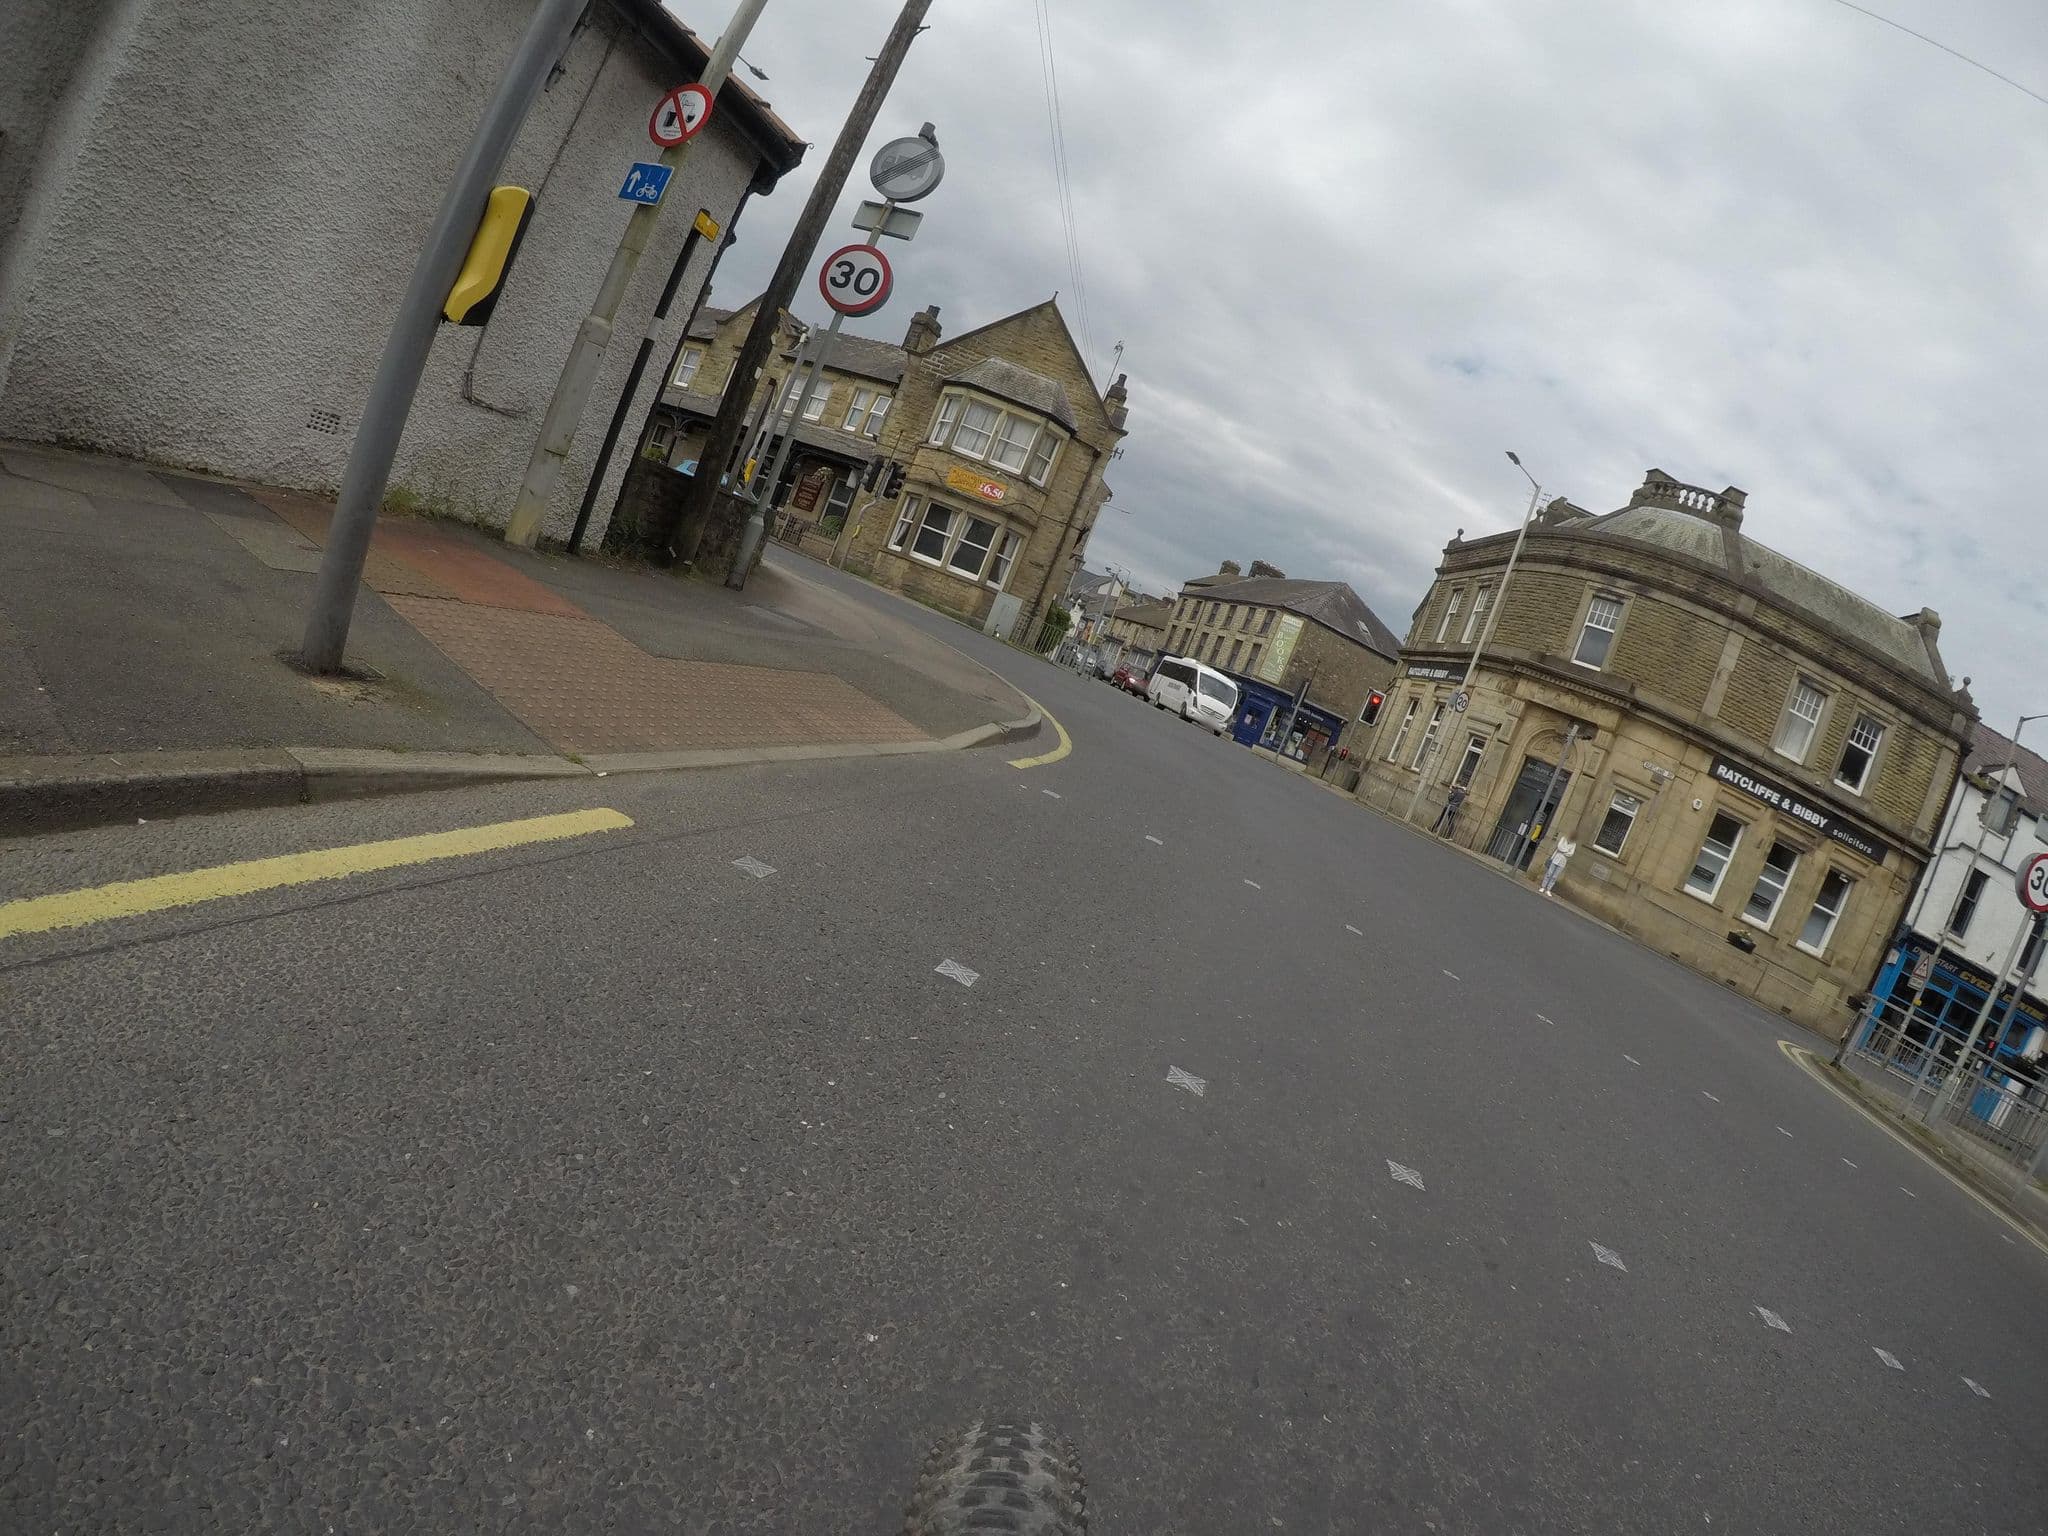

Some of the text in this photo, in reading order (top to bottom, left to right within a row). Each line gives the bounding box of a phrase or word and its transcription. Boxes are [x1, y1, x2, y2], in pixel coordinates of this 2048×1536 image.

[830, 260, 880, 296] 30
[1457, 697, 1468, 708] 20
[1716, 764, 1873, 855] RATCLIFFE & BIBBY solicitors
[1936, 958, 1959, 973] START
[1960, 970, 1992, 992] CYCL
